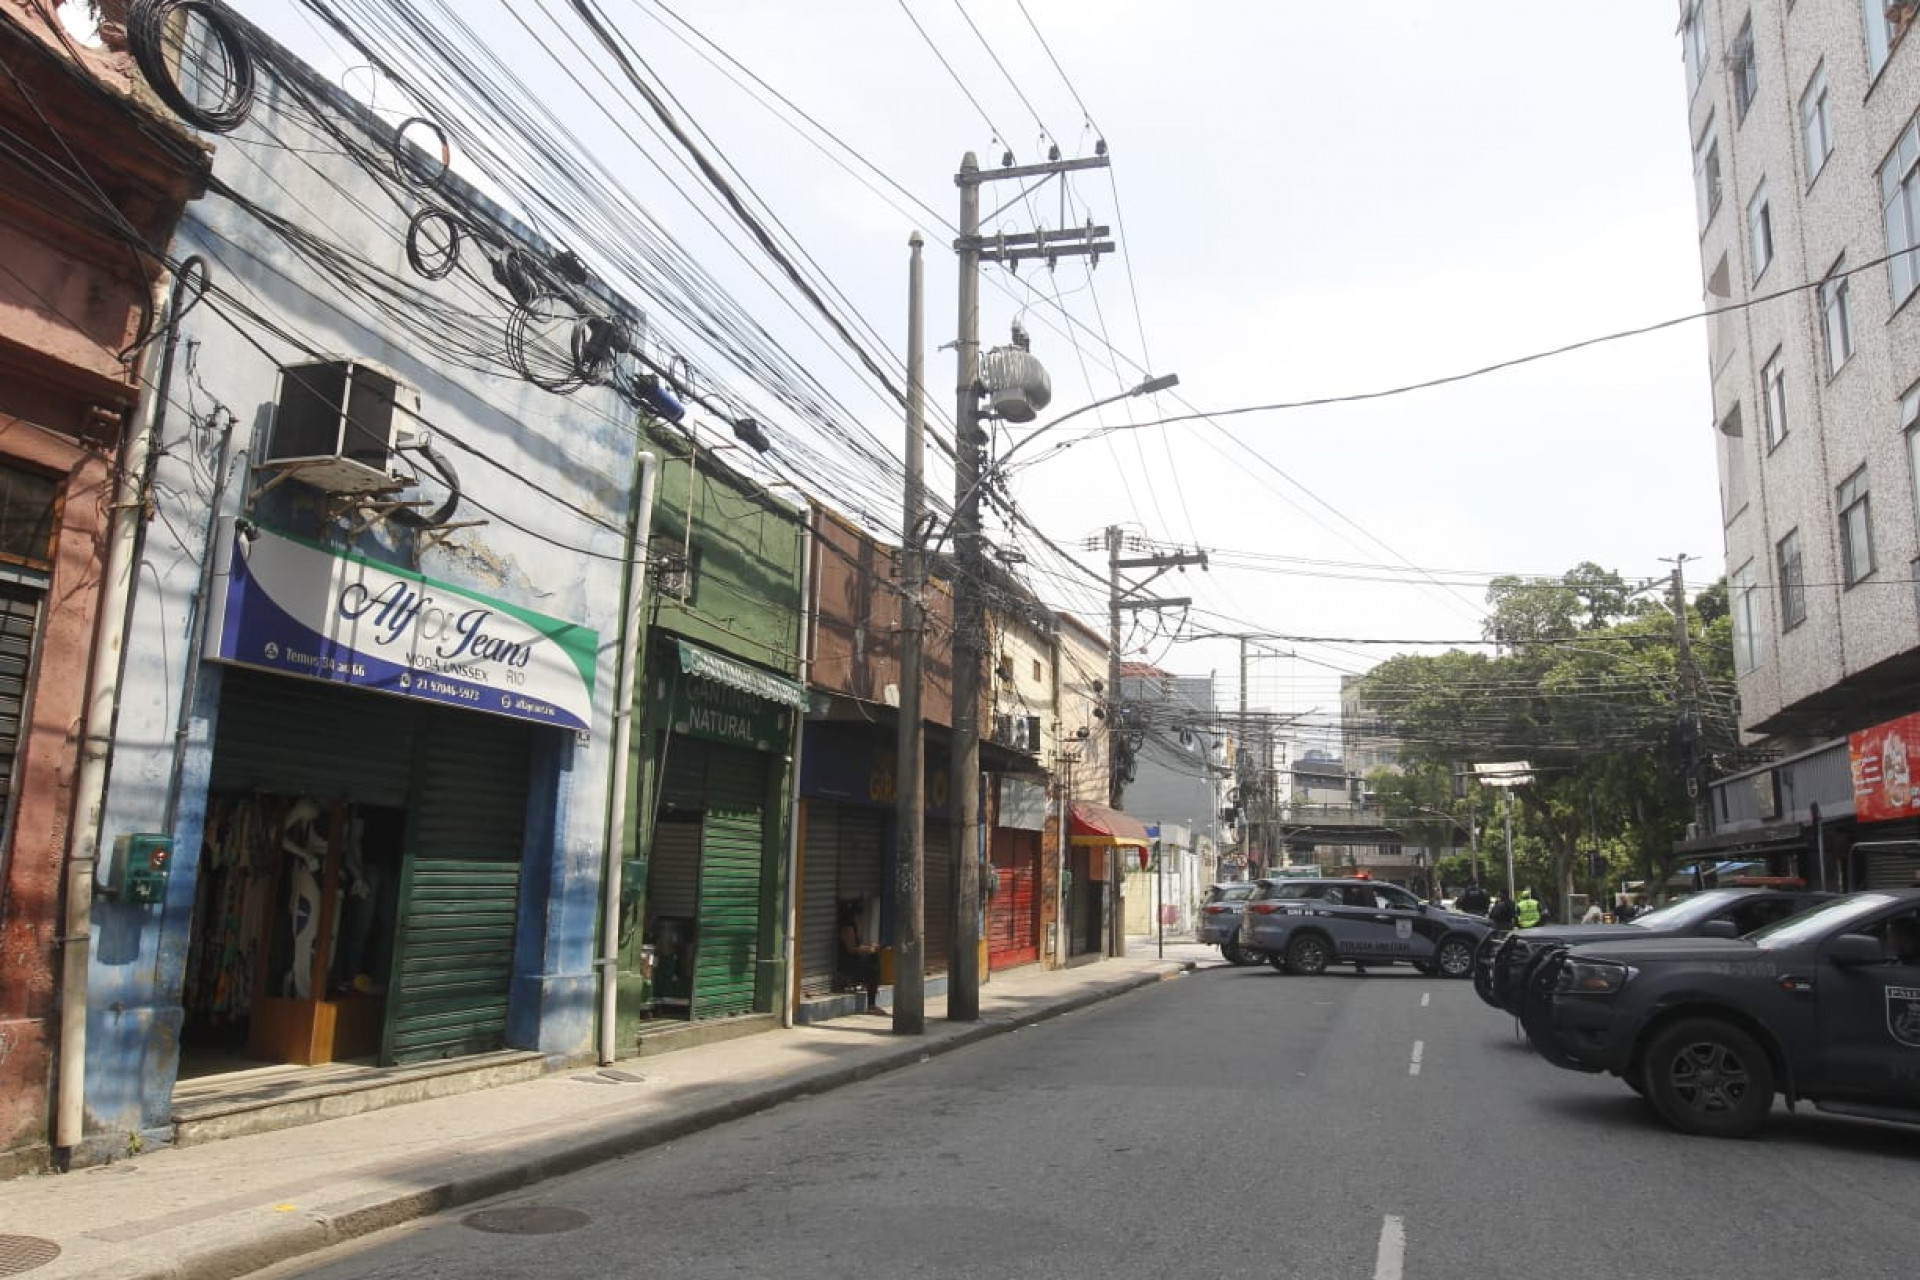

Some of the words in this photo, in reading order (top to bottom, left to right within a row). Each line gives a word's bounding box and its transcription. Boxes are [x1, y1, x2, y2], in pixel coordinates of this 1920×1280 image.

[436, 609, 530, 668] Jeans
[405, 652, 440, 672] MODA
[442, 661, 489, 682] UNISSEX
[506, 669, 526, 686] RIO
[416, 677, 428, 690] 21
[689, 705, 754, 741] NATURAL
